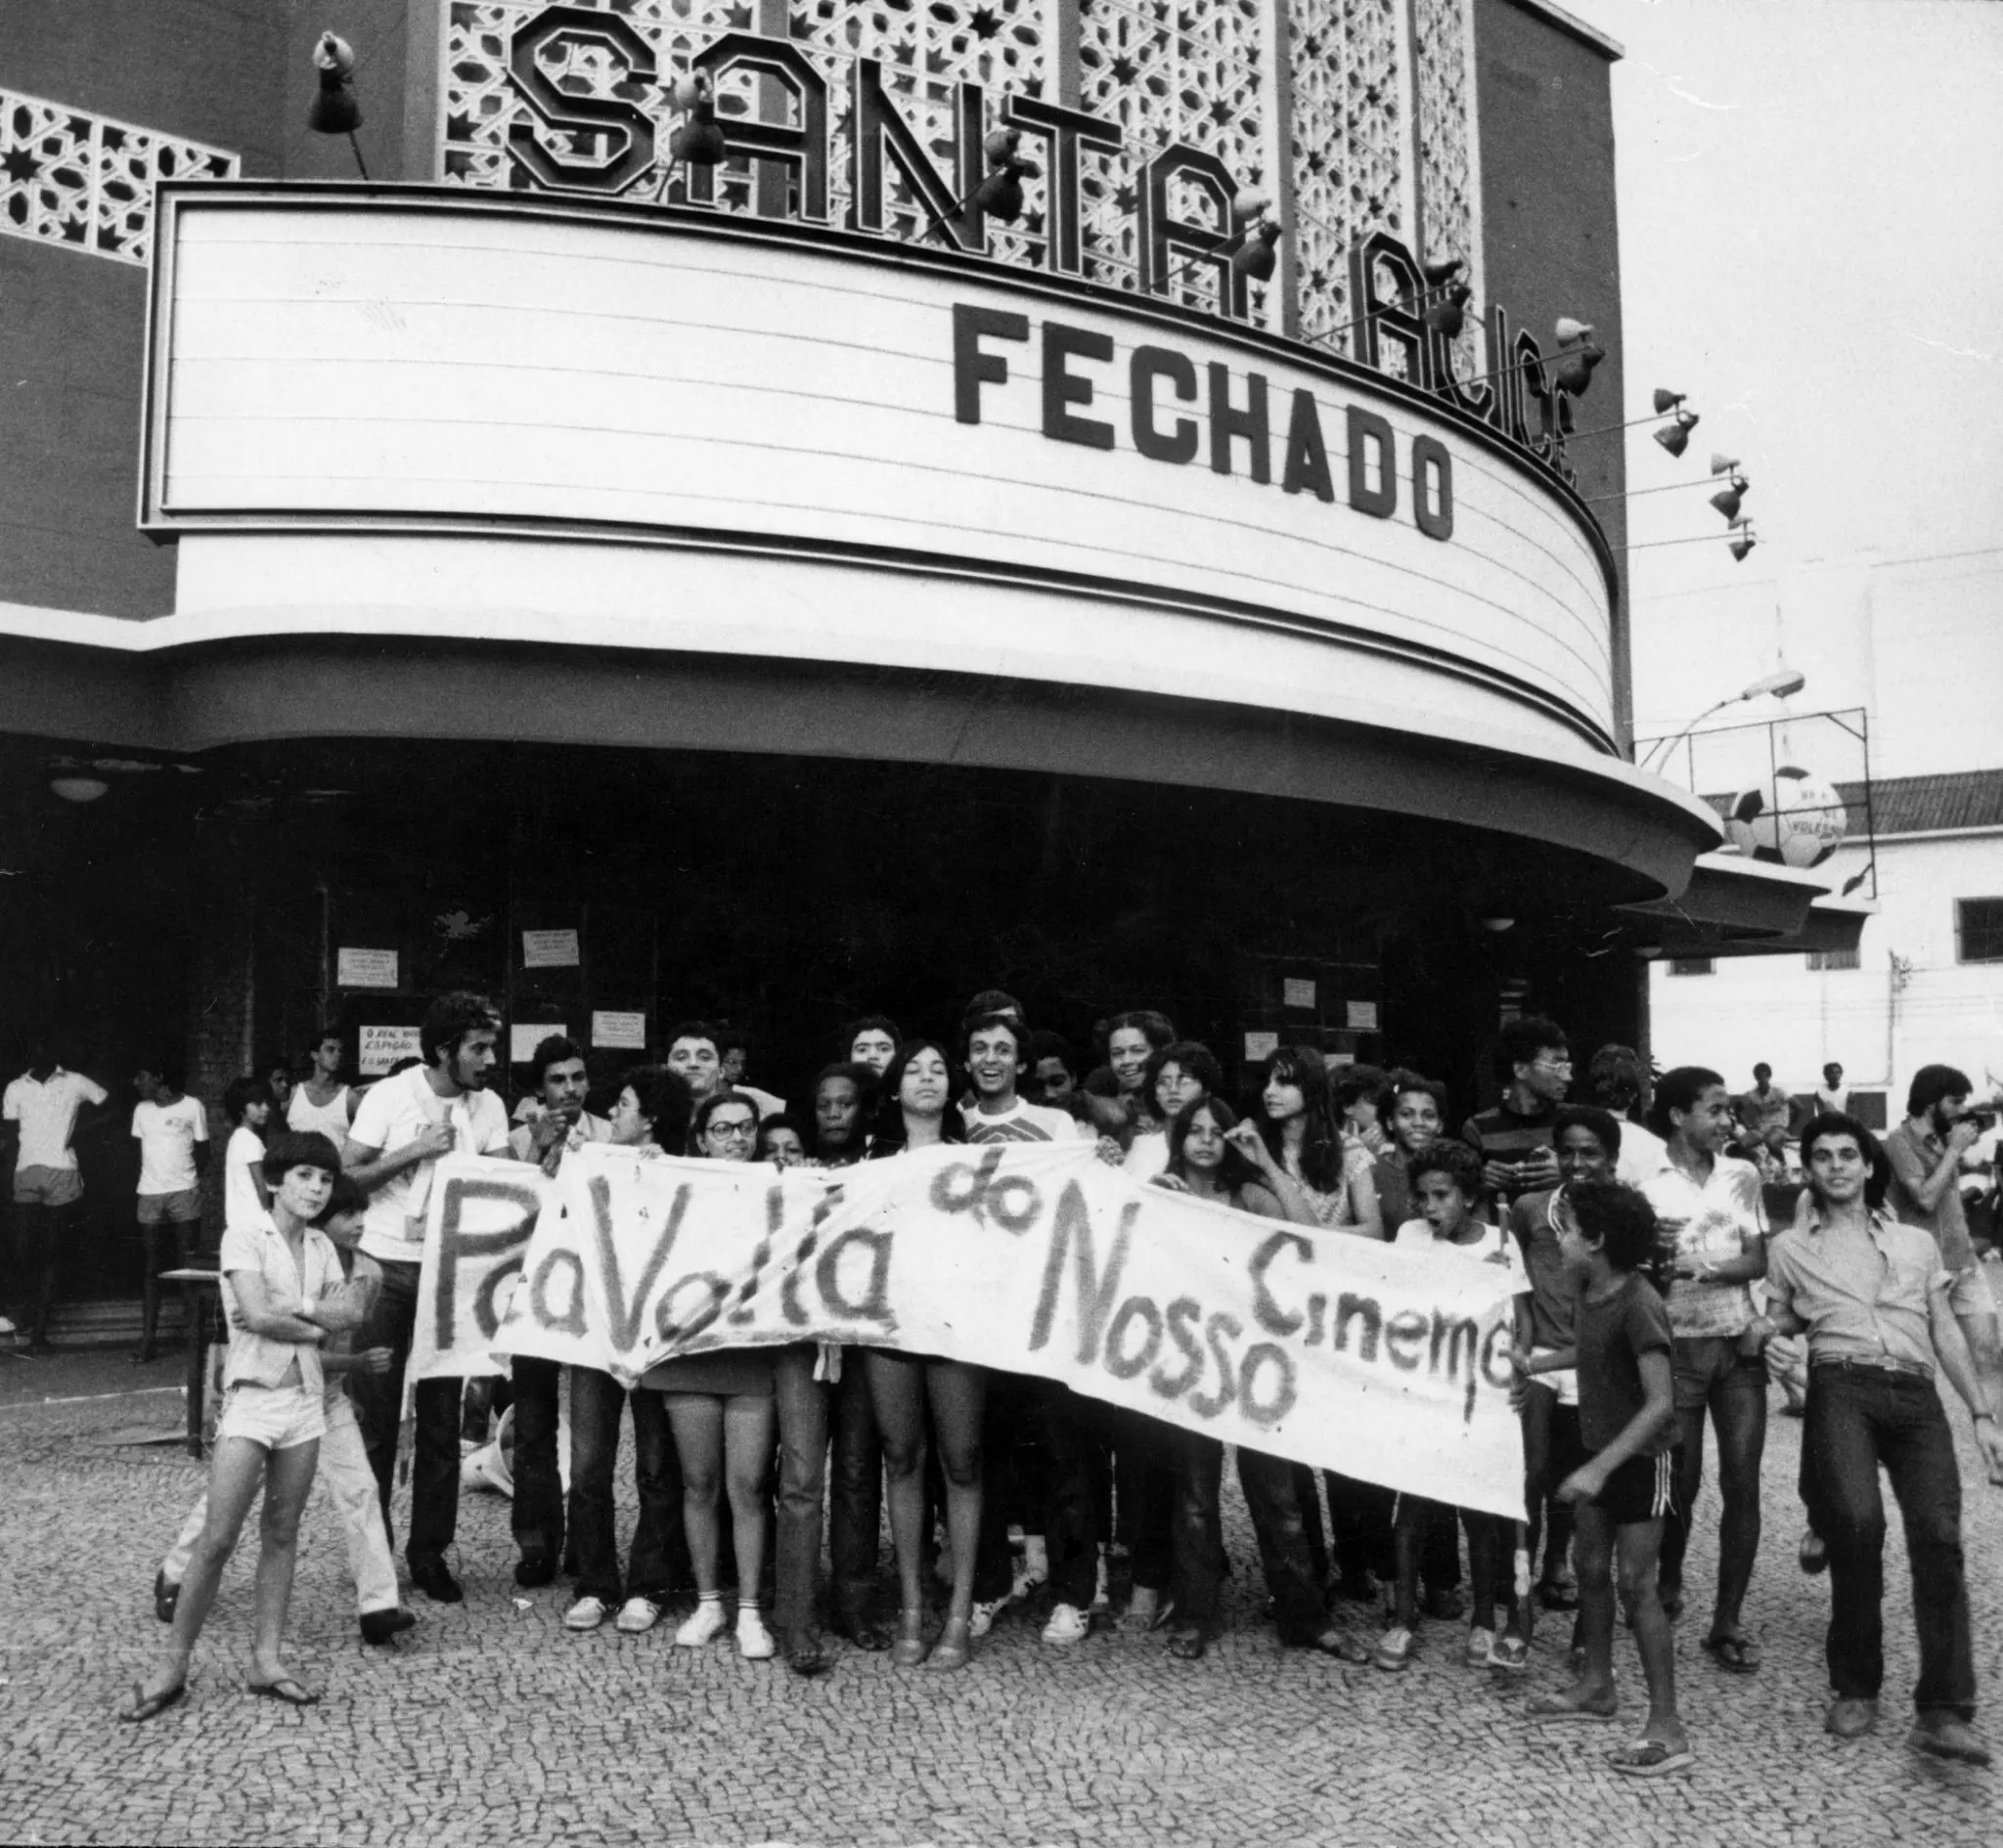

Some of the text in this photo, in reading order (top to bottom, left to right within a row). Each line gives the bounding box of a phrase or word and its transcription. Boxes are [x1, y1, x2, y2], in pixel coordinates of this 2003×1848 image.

[506, 3, 1248, 325] SANTA
[952, 302, 1453, 541] FECHADO
[929, 1146, 1044, 1237] do
[1028, 1179, 1297, 1424] Nosso
[1249, 1229, 1515, 1424] Cinema
